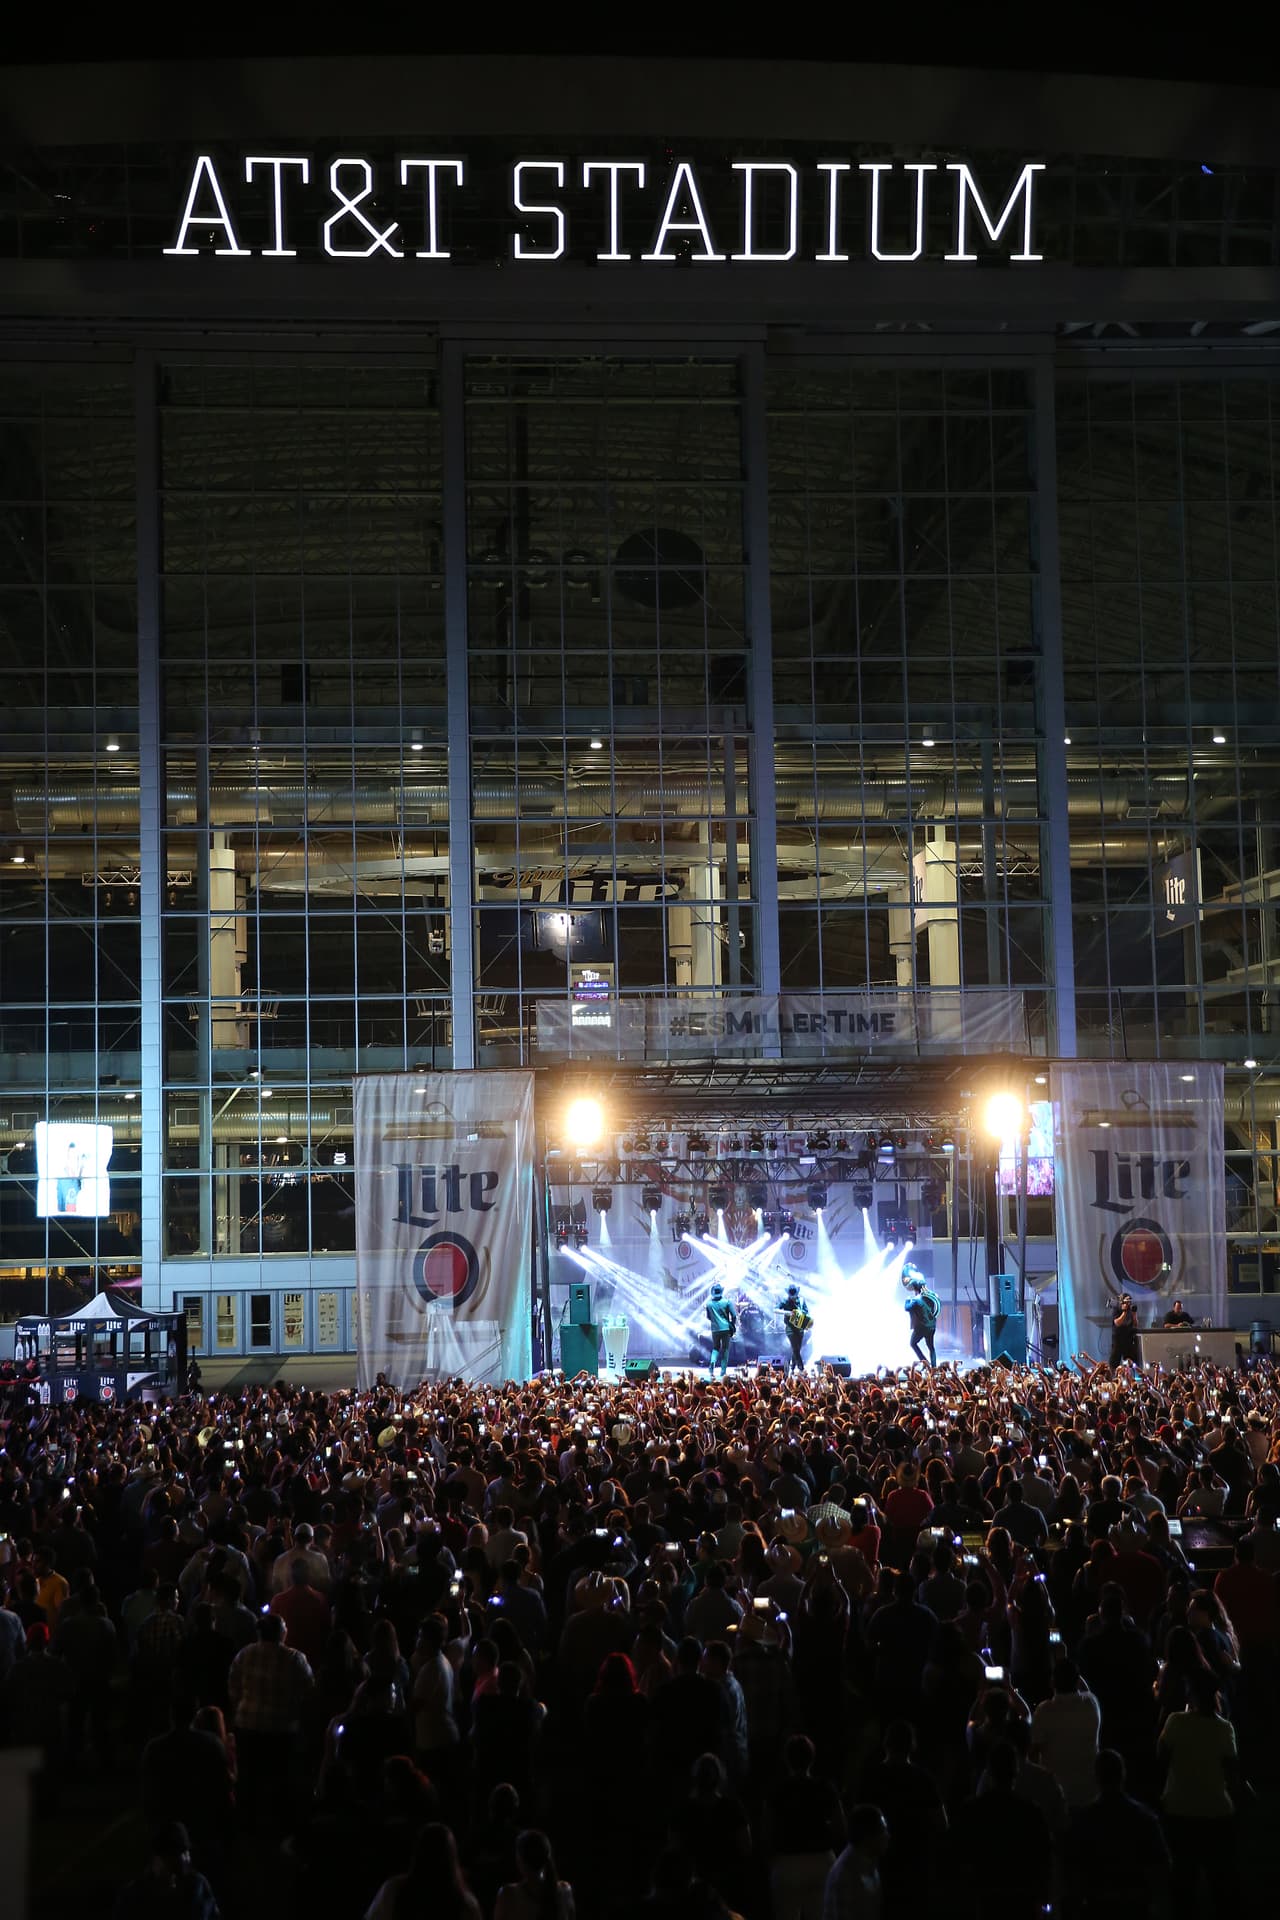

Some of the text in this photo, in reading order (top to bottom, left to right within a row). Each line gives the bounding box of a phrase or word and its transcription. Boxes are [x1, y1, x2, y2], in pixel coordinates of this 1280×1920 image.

[163, 155, 1046, 262] AT&T STADIUM
[1165, 876, 1185, 921] Lite
[391, 1162, 500, 1229] Lite
[1088, 1149, 1191, 1215] Lite
[105, 1320, 122, 1332] Lite
[100, 1376, 115, 1387] Lite
